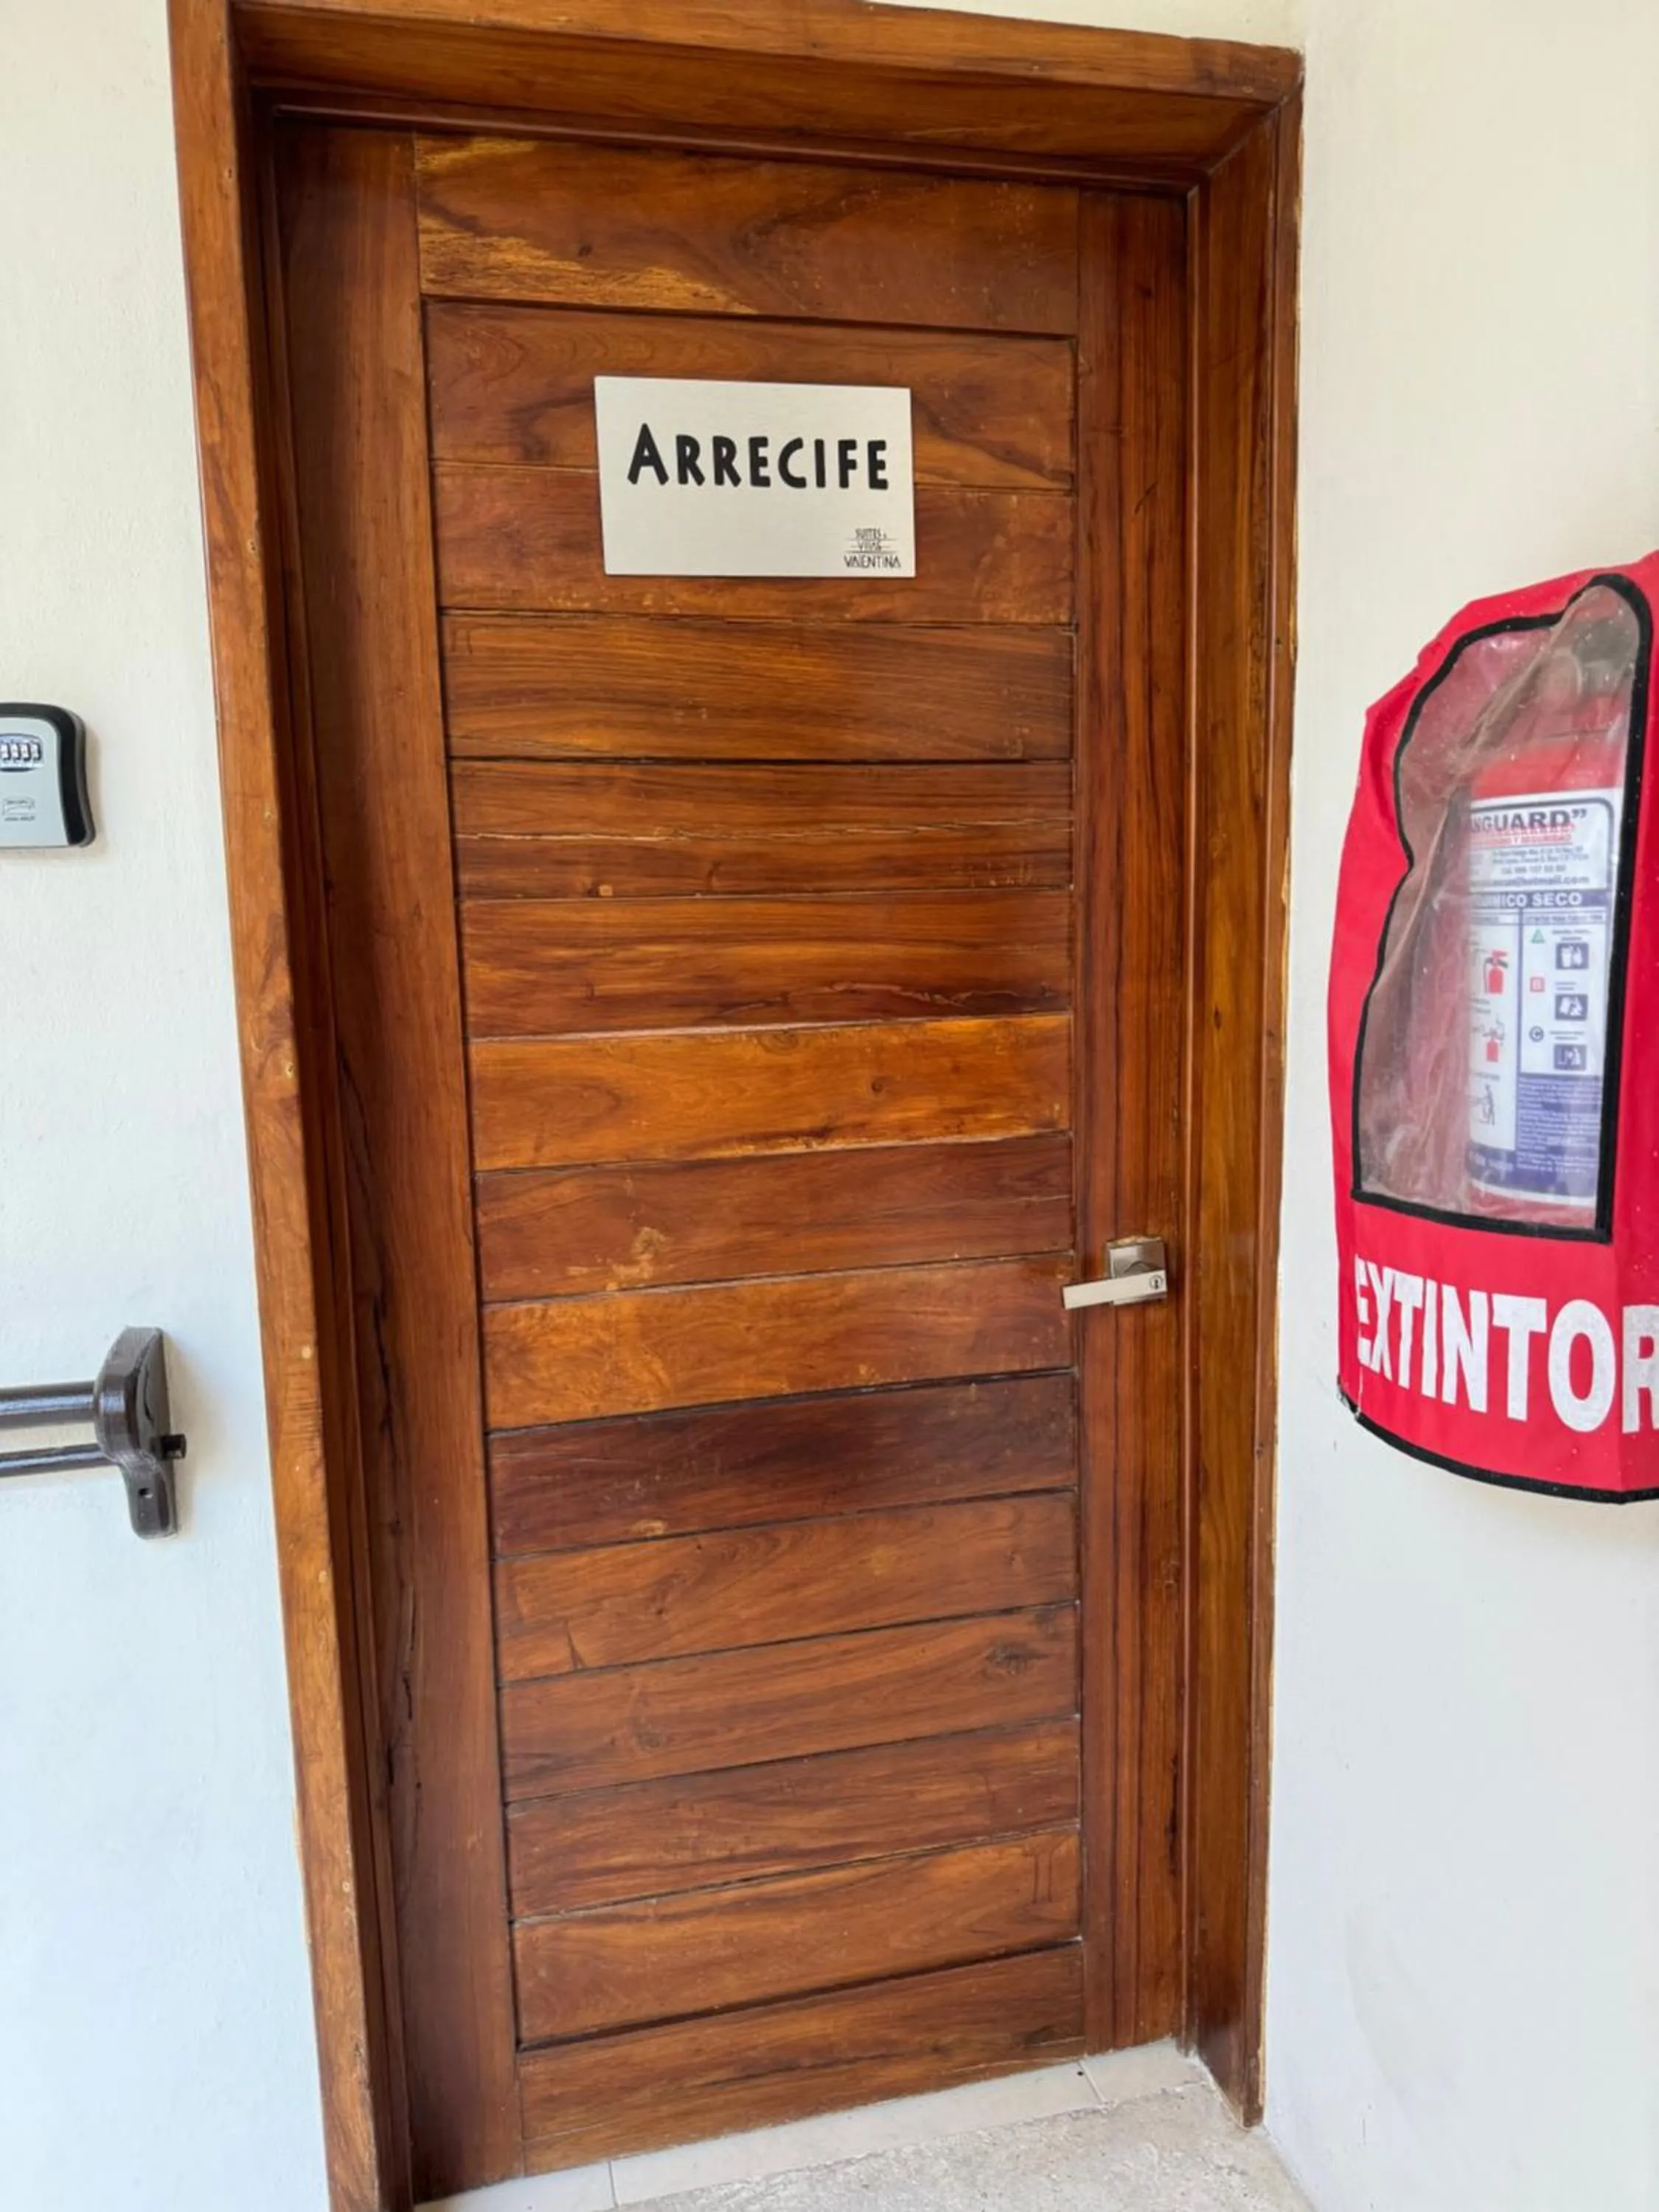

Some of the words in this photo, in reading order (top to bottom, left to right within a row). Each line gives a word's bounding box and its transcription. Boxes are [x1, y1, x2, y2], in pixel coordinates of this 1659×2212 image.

[627, 422, 888, 490] ARRECIFE
[1532, 891, 1582, 905] SECO
[1354, 1253, 1659, 1433] EXTINTOR
